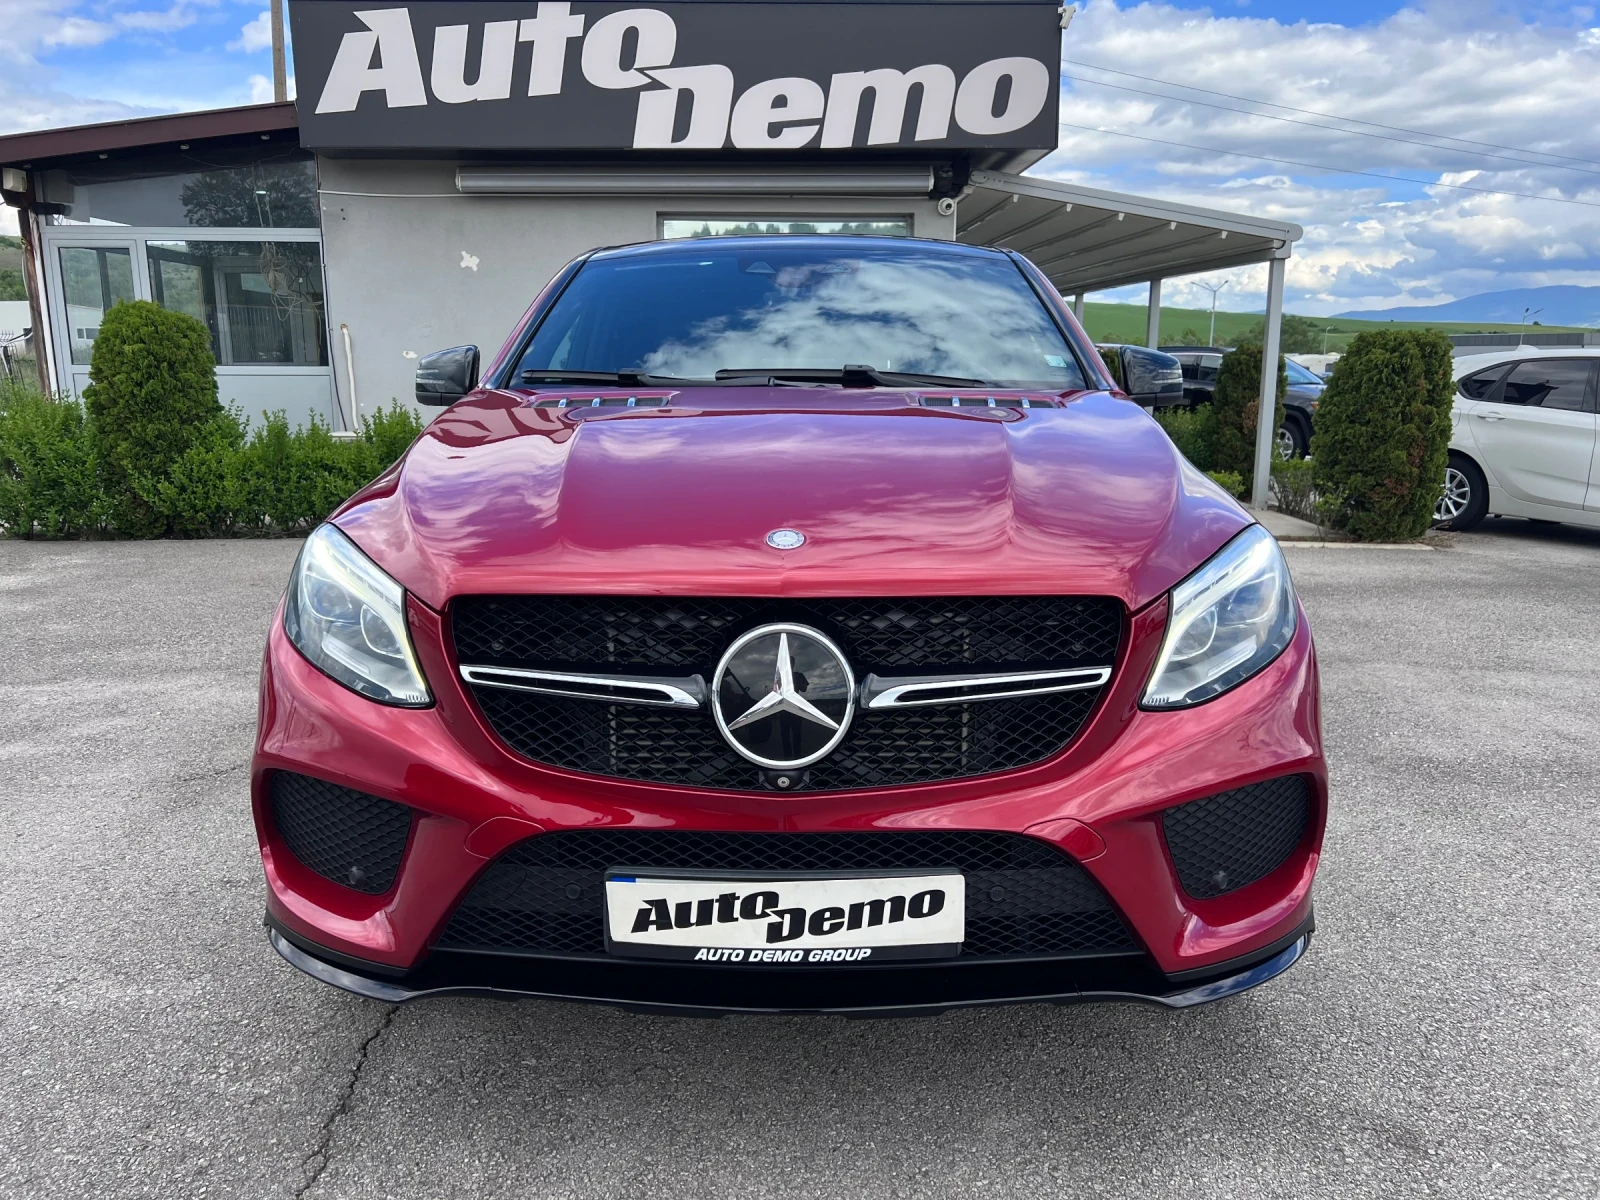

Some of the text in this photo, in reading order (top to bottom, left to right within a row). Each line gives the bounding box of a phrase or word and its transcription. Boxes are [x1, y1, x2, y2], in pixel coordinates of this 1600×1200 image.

[315, 1, 1050, 149] Auto Demo
[631, 889, 946, 944] Auto Demo
[694, 948, 872, 962] AUTO DEMO GROUP
